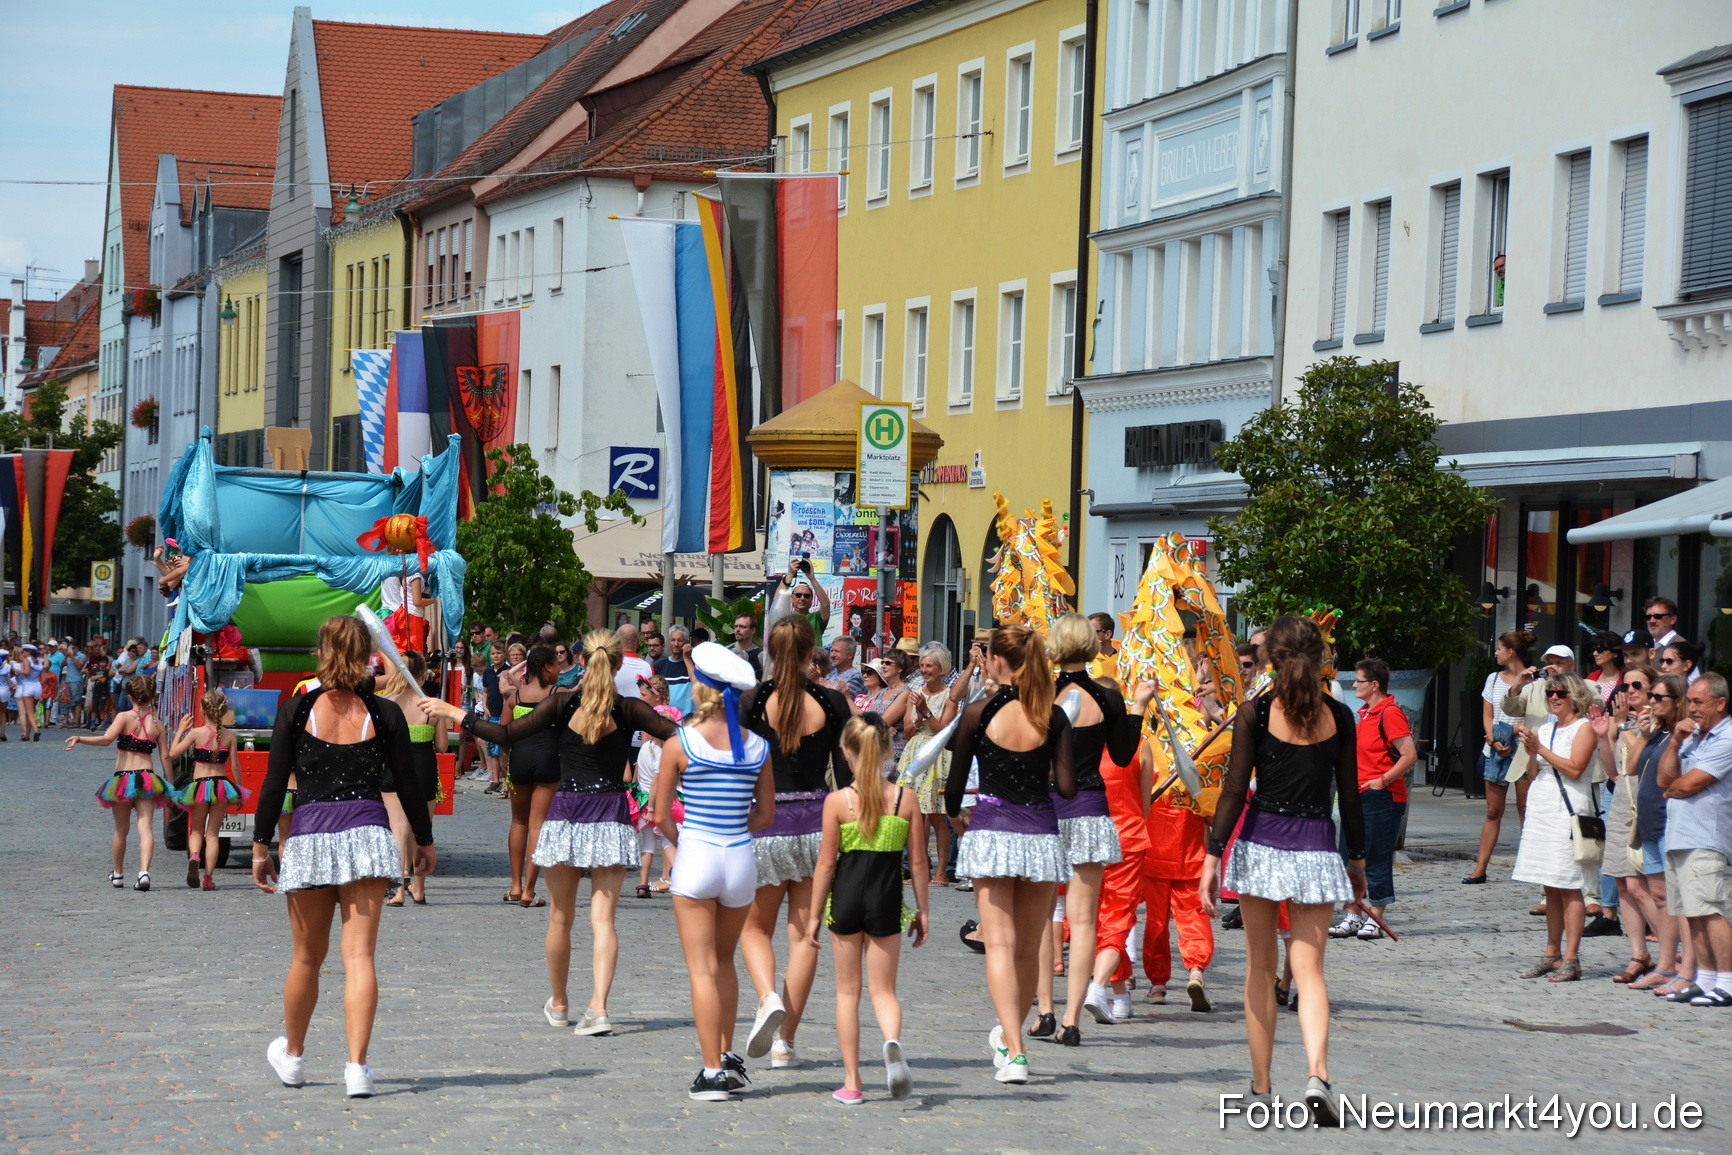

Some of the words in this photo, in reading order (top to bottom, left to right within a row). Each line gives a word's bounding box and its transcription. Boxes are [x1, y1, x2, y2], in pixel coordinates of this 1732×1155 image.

[1160, 143, 1200, 187] BRILLEN
[1203, 130, 1239, 174] WEBER
[875, 418, 894, 441] H
[867, 453, 901, 461] Marktplatz
[855, 510, 880, 518] onn
[639, 551, 740, 562] Nemarer
[619, 557, 762, 571] Lammsräu
